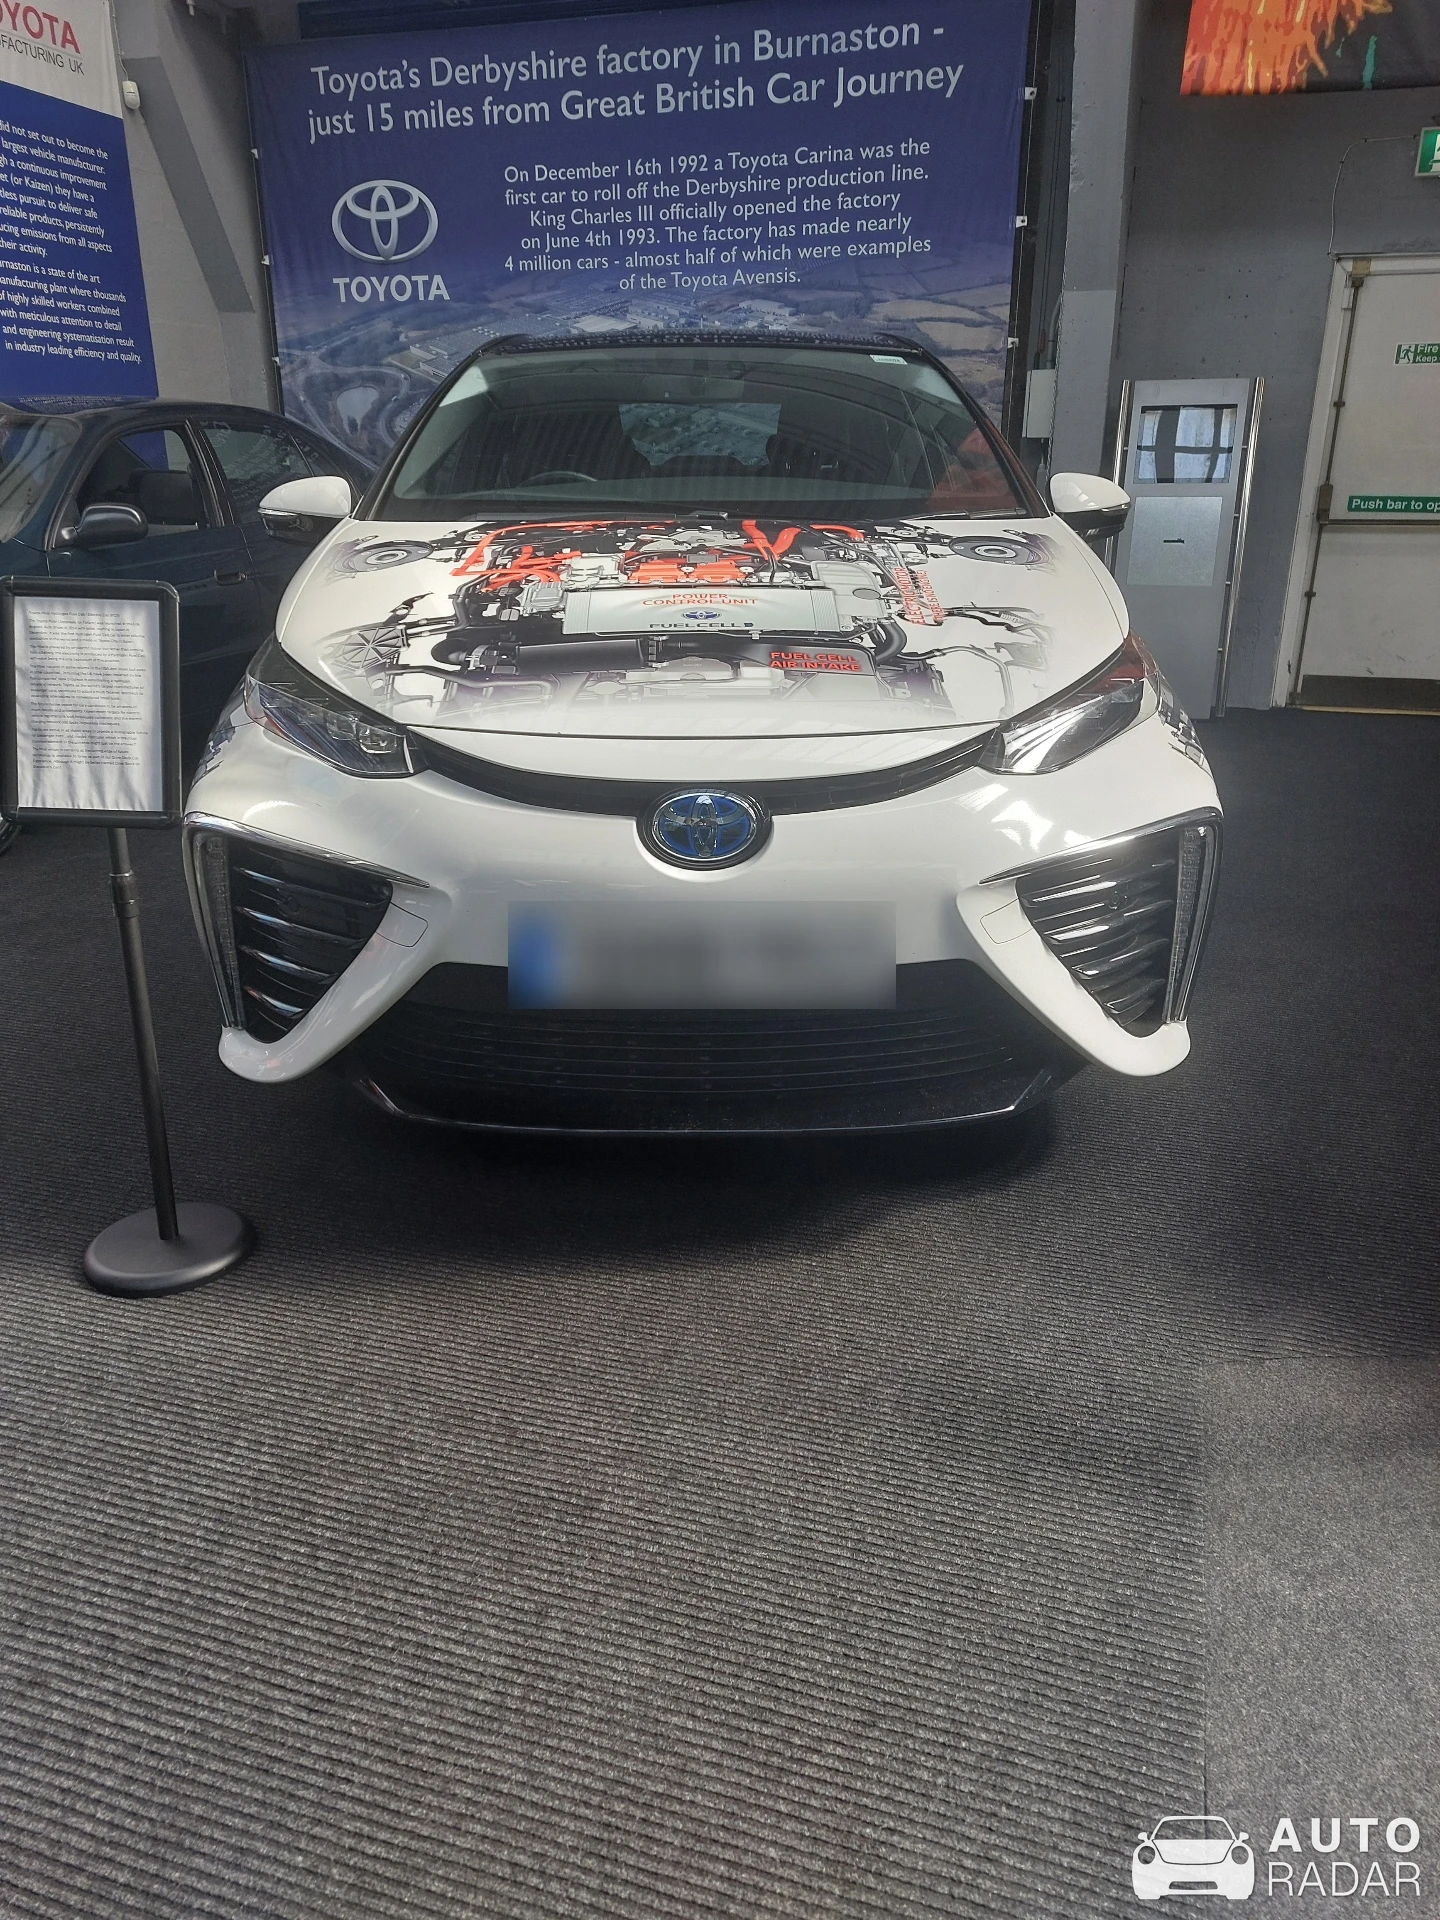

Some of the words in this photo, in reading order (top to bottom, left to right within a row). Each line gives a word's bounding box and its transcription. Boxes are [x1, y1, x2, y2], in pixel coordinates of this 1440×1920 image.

[0, 0, 81, 54] YOTA
[0, 34, 64, 68] FACTURING
[310, 60, 421, 101] Toyota's
[430, 50, 587, 91] Derbyshire
[596, 44, 703, 77] factory
[714, 34, 740, 65] in
[754, 21, 920, 61] Burnaston
[308, 109, 356, 144] just
[367, 103, 394, 132] 15
[404, 100, 474, 130] miles
[482, 96, 550, 125] from
[561, 90, 645, 120] Great
[656, 76, 754, 113] British
[767, 72, 825, 104] Car
[833, 64, 964, 108] Journey
[1, 136, 29, 154] largest
[29, 146, 56, 162] vehicle
[57, 154, 106, 174] manufacturer.
[12, 126, 26, 137] not
[28, 130, 40, 140] set
[41, 134, 55, 145] out
[56, 137, 66, 148] to
[66, 138, 95, 157] become
[96, 148, 108, 160] the
[504, 166, 529, 182] On
[534, 162, 619, 182] December
[627, 158, 662, 176] 16th
[670, 154, 708, 174] 1992
[714, 158, 724, 171] a
[728, 152, 788, 173] Toyota
[795, 145, 853, 165] Carina
[860, 145, 894, 159] was
[900, 138, 930, 156] the
[10, 158, 15, 167] a
[17, 161, 59, 178] continuous
[60, 169, 107, 190] improvement
[505, 189, 536, 205] first
[541, 191, 566, 204] car
[571, 188, 588, 203] to
[594, 184, 620, 201] roll
[627, 182, 648, 199] off
[652, 181, 680, 198] the
[686, 175, 781, 198] Derbyshire
[787, 168, 885, 195] production
[891, 164, 929, 182] line.
[10, 172, 23, 187] (or
[24, 176, 53, 195] Kaizen)
[55, 184, 71, 199] they
[73, 188, 89, 201] have
[89, 195, 95, 203] a
[19, 194, 47, 208] pursuit
[48, 200, 56, 209] to
[58, 200, 82, 215] deliver
[84, 208, 98, 219] safe
[530, 210, 566, 230] King
[571, 207, 632, 225] Charles
[638, 205, 653, 222] III
[659, 201, 727, 223] officially
[733, 196, 797, 220] opened
[803, 195, 831, 212] the
[837, 192, 901, 211] factory
[29, 212, 64, 228] products,
[65, 220, 105, 238] persistently
[521, 236, 540, 249] on
[545, 232, 580, 253] June
[585, 230, 611, 246] 4th
[619, 228, 660, 245] 1993.
[665, 226, 698, 243] The
[703, 225, 762, 243] factory
[768, 221, 796, 238] has
[802, 217, 850, 236] made
[856, 212, 912, 234] nearly
[19, 243, 48, 258] activity.
[21, 227, 57, 242] emissions
[58, 232, 77, 246] from
[78, 236, 86, 247] all
[87, 240, 113, 253] aspects
[505, 255, 513, 271] 4
[519, 255, 571, 271] million
[577, 256, 609, 270] cars
[625, 251, 680, 268] almost
[685, 247, 716, 265] half
[720, 246, 738, 263] of
[741, 244, 791, 262] which
[798, 245, 841, 259] were
[847, 236, 931, 258] examples
[33, 263, 40, 273] is
[41, 266, 46, 275] a
[47, 267, 66, 278] state
[67, 269, 75, 280] of
[76, 270, 88, 282] the
[89, 274, 101, 284] art
[619, 274, 636, 290] of
[640, 273, 667, 289] the
[671, 272, 727, 292] Toyota
[733, 268, 801, 285] Avensis.
[0, 276, 48, 293] anufacturing
[49, 282, 68, 294] plant
[69, 285, 92, 297] where
[92, 288, 127, 303] thousands
[333, 274, 450, 302] TOYOTA
[6, 291, 29, 307] highly
[31, 295, 55, 308] skilled
[56, 299, 86, 312] workers
[87, 302, 120, 317] combined
[0, 308, 17, 319] with
[19, 311, 60, 324] meticulous
[61, 315, 93, 328] attention
[94, 320, 103, 329] to
[104, 320, 123, 332] detail
[2, 324, 17, 335] and
[19, 326, 62, 342] engineering
[63, 331, 115, 345] systematisation
[115, 337, 135, 348] result
[1417, 344, 1439, 353] Fire
[4, 339, 13, 351] in
[14, 340, 46, 356] industry
[47, 343, 74, 358] leading
[74, 346, 105, 361] efficiency
[106, 350, 119, 361] and
[120, 351, 143, 365] quality.
[1415, 355, 1438, 363] Keep
[1351, 498, 1384, 509] Push
[1386, 499, 1408, 510] bar
[1410, 500, 1423, 510] to
[894, 567, 913, 590] MOTOR
[642, 598, 713, 606] CONTROL
[904, 590, 926, 624] ELECTRIC
[769, 660, 798, 669] AIR
[801, 661, 861, 672] INTAKE
[770, 652, 812, 660] FUEL
[815, 653, 858, 663] CELL
